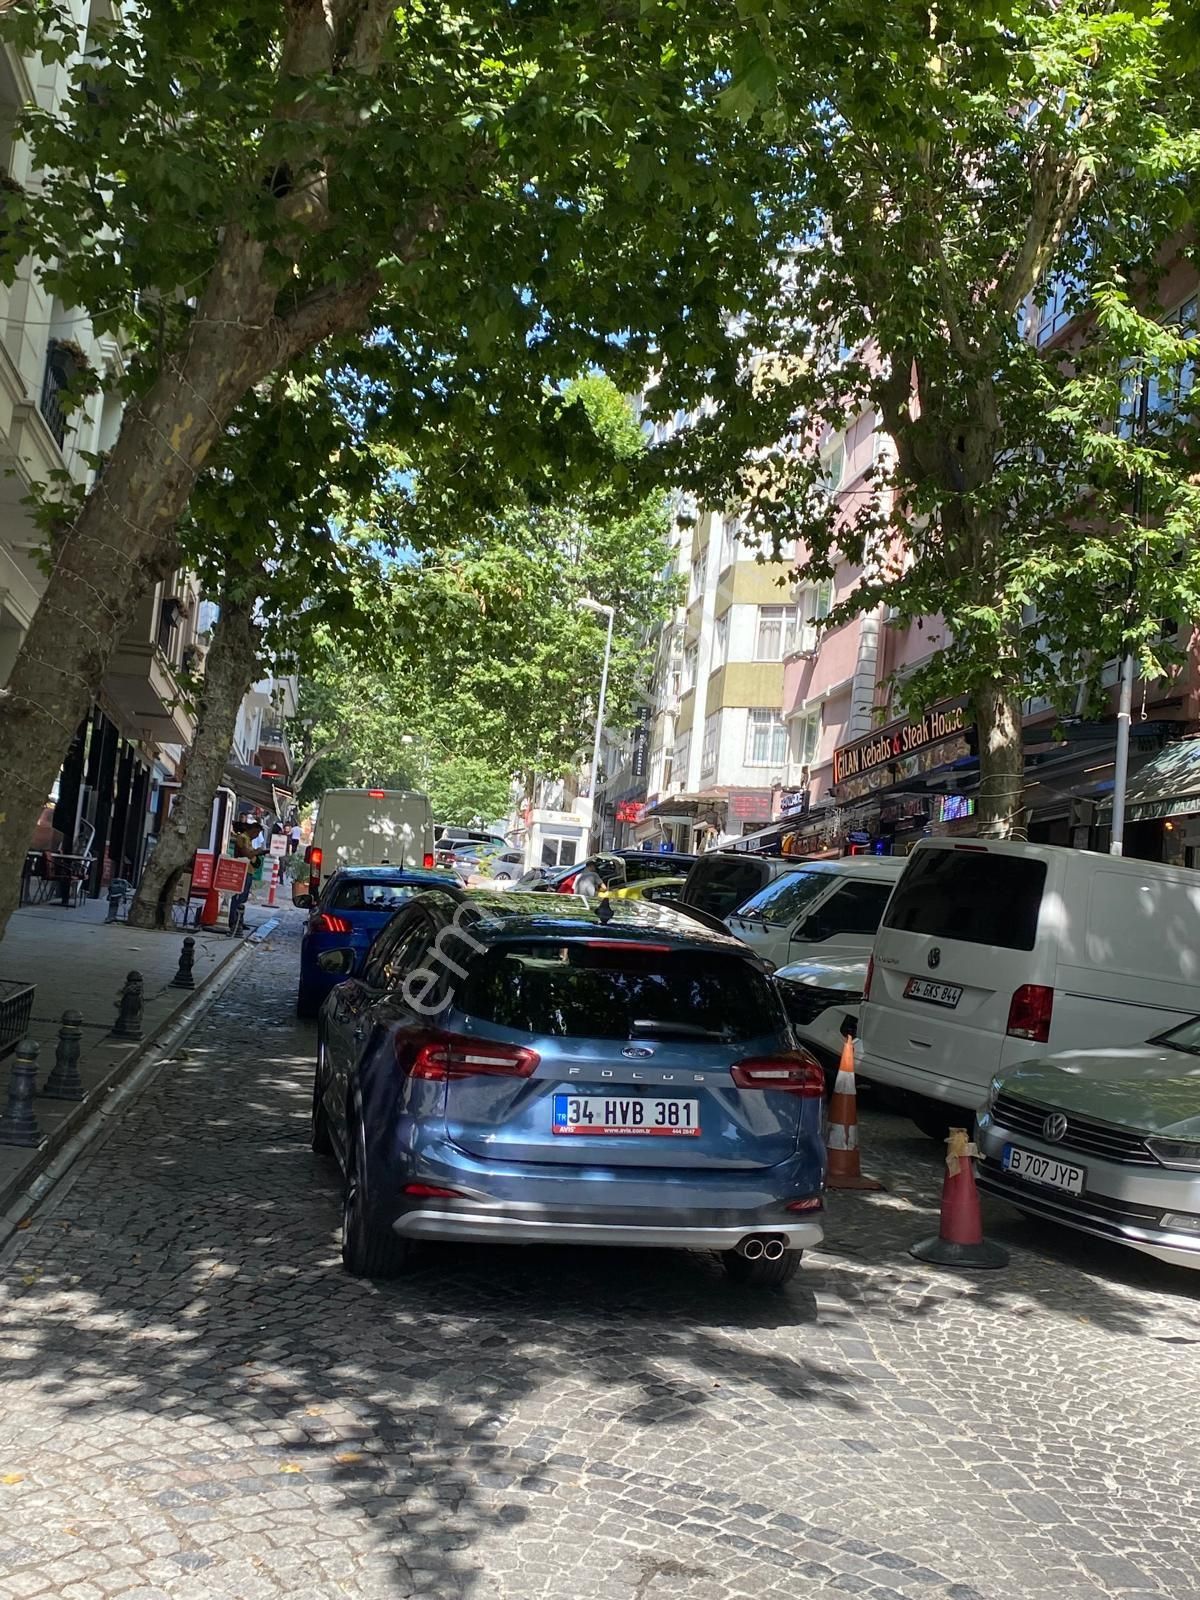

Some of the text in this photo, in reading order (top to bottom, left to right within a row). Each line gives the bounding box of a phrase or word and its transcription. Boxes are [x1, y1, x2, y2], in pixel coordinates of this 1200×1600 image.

[861, 736, 891, 770] Kebabs
[892, 731, 901, 755] &
[902, 715, 929, 751] Steak
[911, 981, 921, 995] 34
[941, 986, 958, 1003] 844
[569, 1067, 704, 1080] FOCUS
[557, 1113, 567, 1121] TR
[568, 1099, 692, 1127] 34 HVB 381
[1011, 1151, 1079, 1187] B 707 JYP
